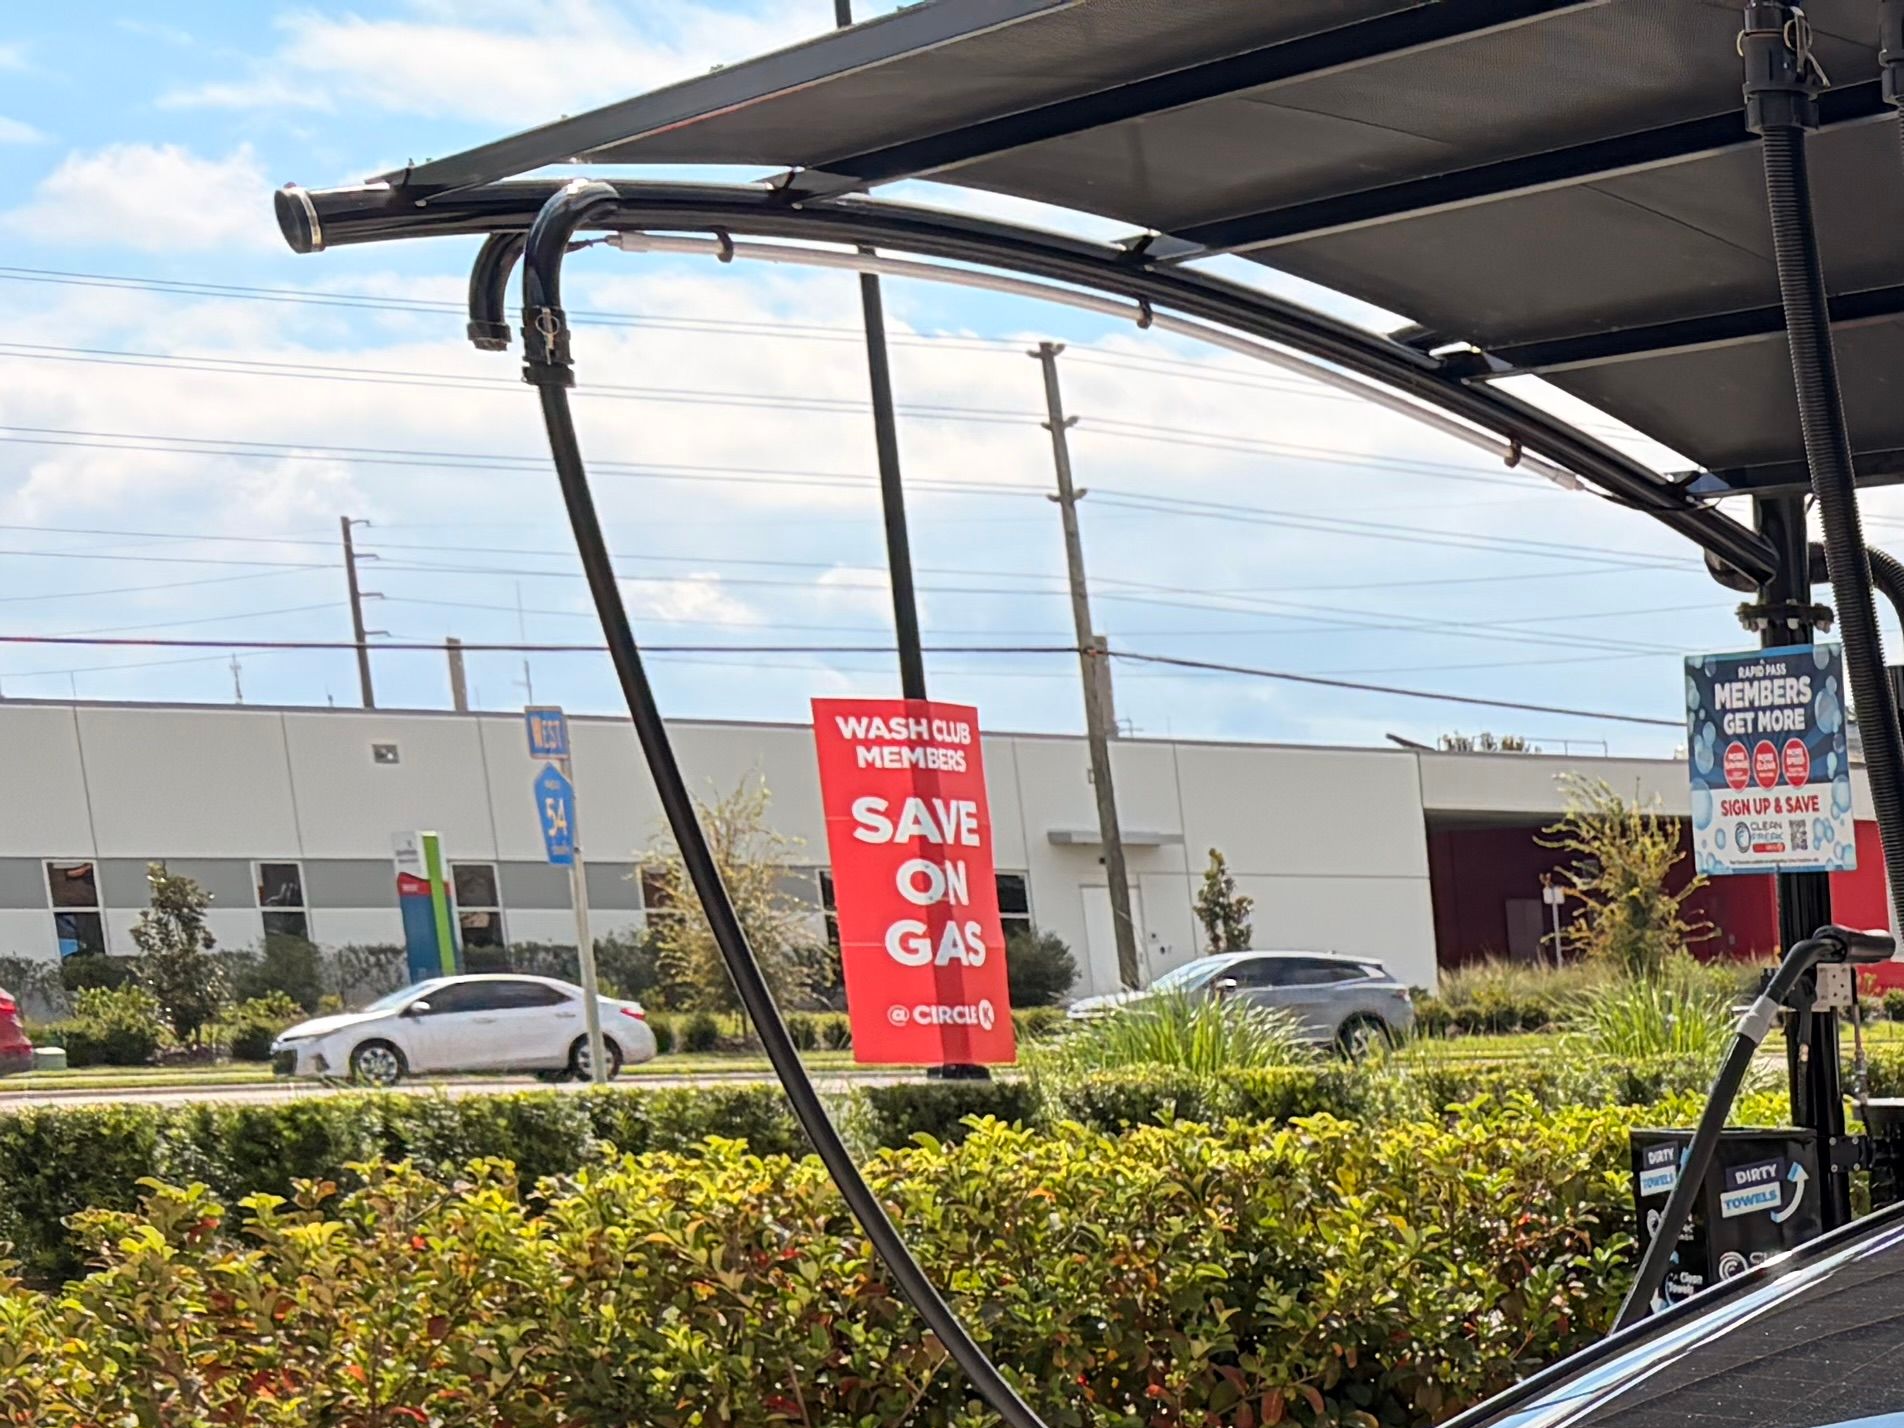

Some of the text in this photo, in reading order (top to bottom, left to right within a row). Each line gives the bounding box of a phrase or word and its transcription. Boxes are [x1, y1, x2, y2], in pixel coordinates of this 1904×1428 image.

[1714, 676, 1812, 710] MEMBERS
[835, 716, 971, 745] WASH CLUB
[1723, 708, 1805, 735] GET MORE
[856, 746, 966, 773] MEMBERS
[1720, 795, 1820, 816] SIGN UP & SAVE
[852, 797, 980, 847] SAVE
[896, 858, 969, 906] ON
[885, 920, 986, 967] GAS
[887, 1004, 910, 1027] @
[912, 1004, 978, 1025] CIRCLE
[1648, 1148, 1674, 1165] DIRTY
[1735, 1164, 1777, 1184] DIRTY
[1724, 1190, 1777, 1210] TOWELS
